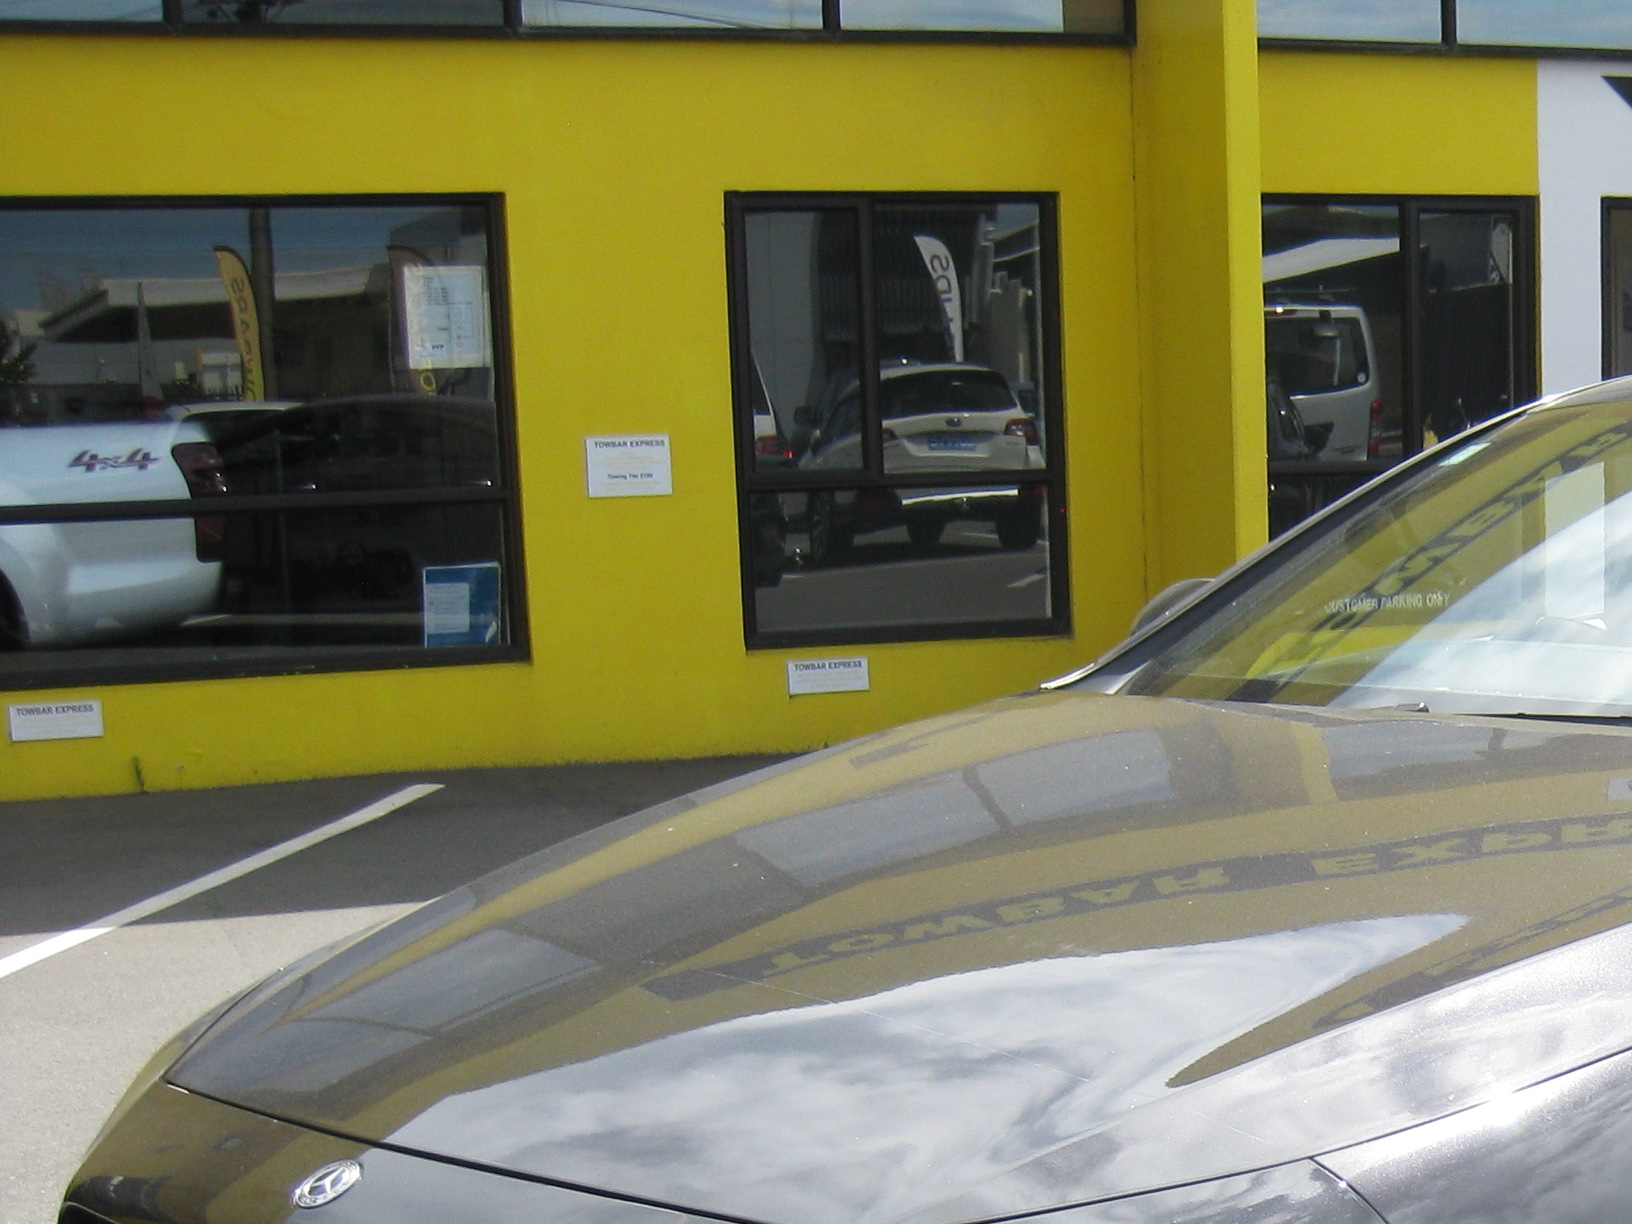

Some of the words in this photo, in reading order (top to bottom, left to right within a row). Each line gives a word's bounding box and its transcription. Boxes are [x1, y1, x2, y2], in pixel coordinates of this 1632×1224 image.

[594, 440, 628, 449] TOWBAR
[630, 439, 665, 448] EXPRESS
[1380, 593, 1423, 610] PARKING
[795, 662, 826, 671] TOWBAR
[828, 660, 861, 669] EXPRESS
[17, 706, 53, 716] TOWBAR
[55, 704, 94, 713] EXPRESS
